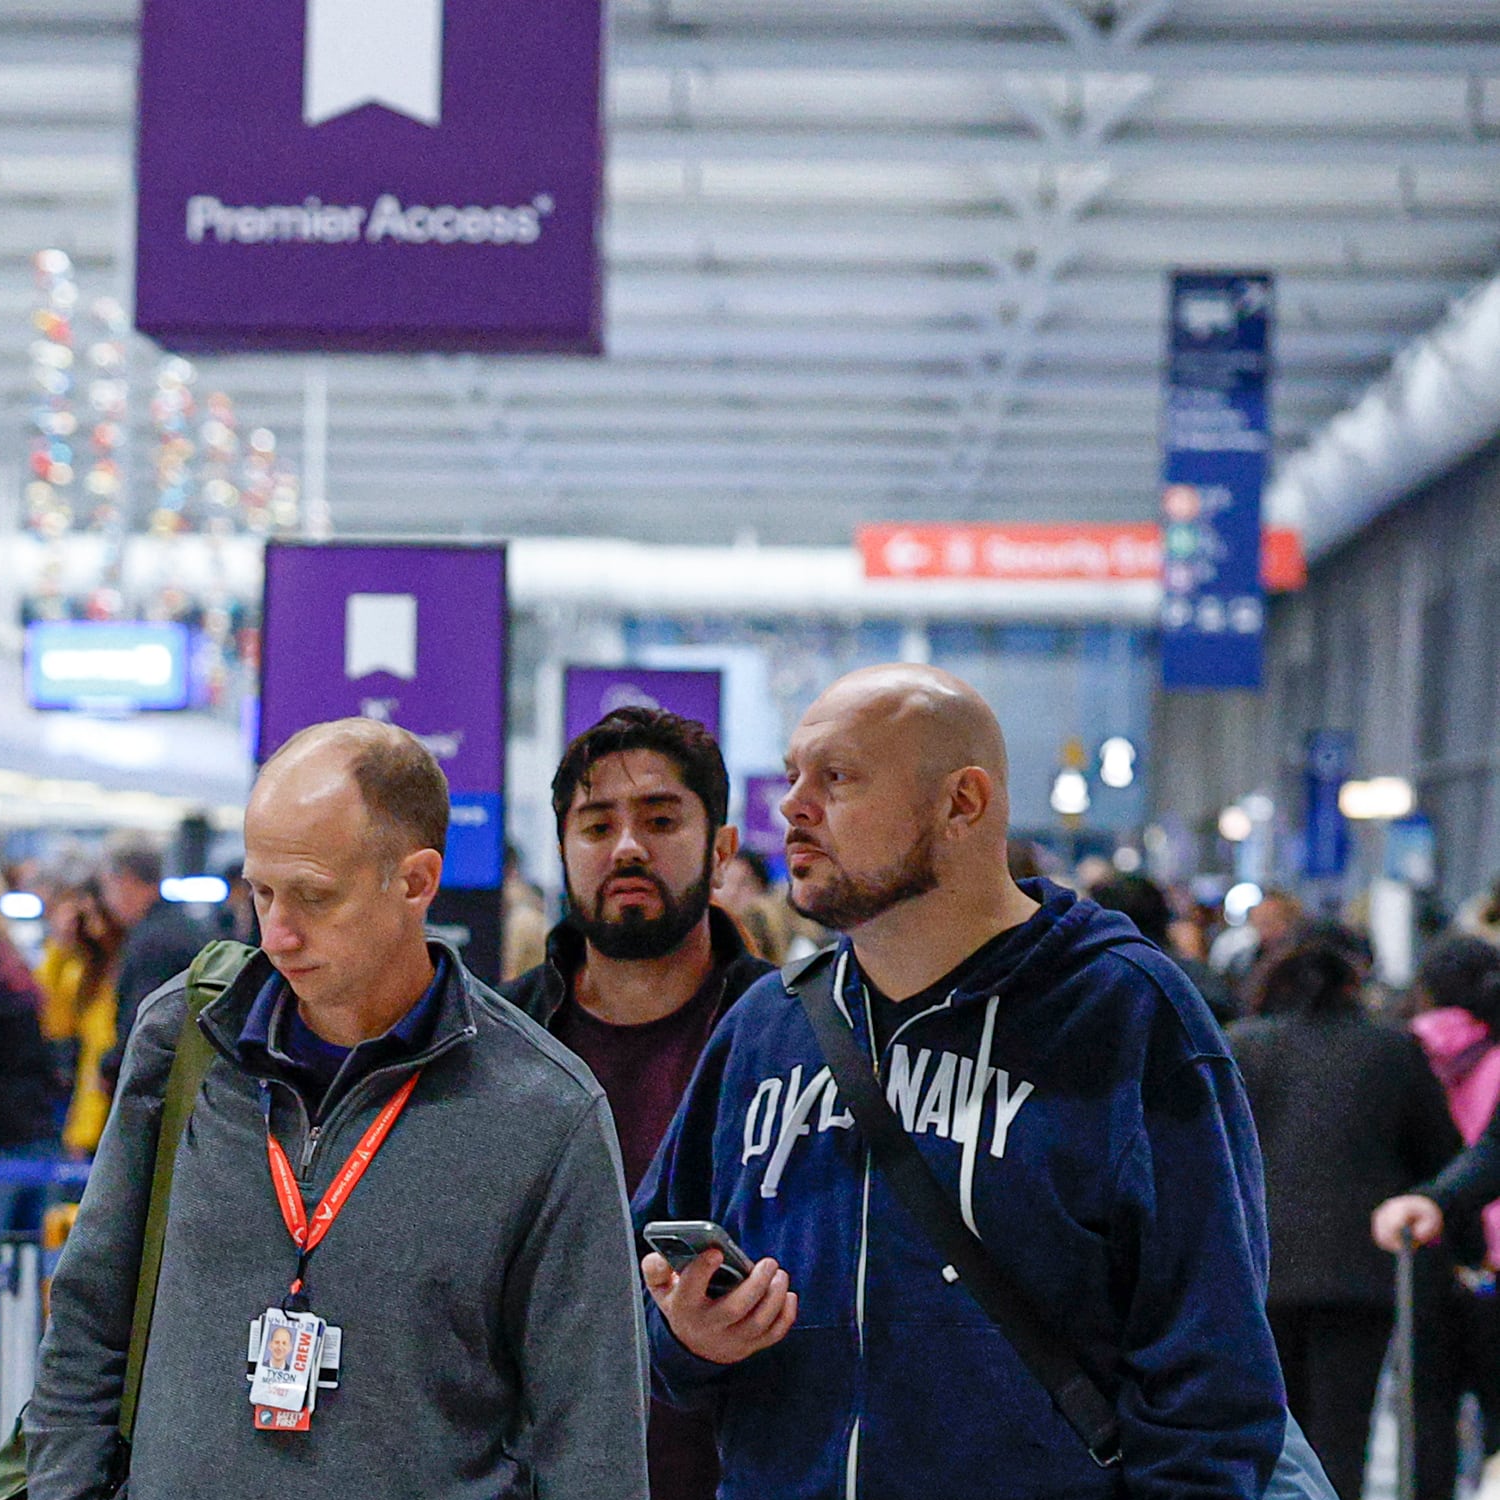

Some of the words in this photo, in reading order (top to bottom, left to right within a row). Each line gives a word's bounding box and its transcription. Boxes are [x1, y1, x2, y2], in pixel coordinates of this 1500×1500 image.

[186, 195, 366, 245] Premier
[887, 1043, 1035, 1159] NAVY
[293, 1331, 313, 1373] CREW
[267, 1368, 298, 1384] TYSON
